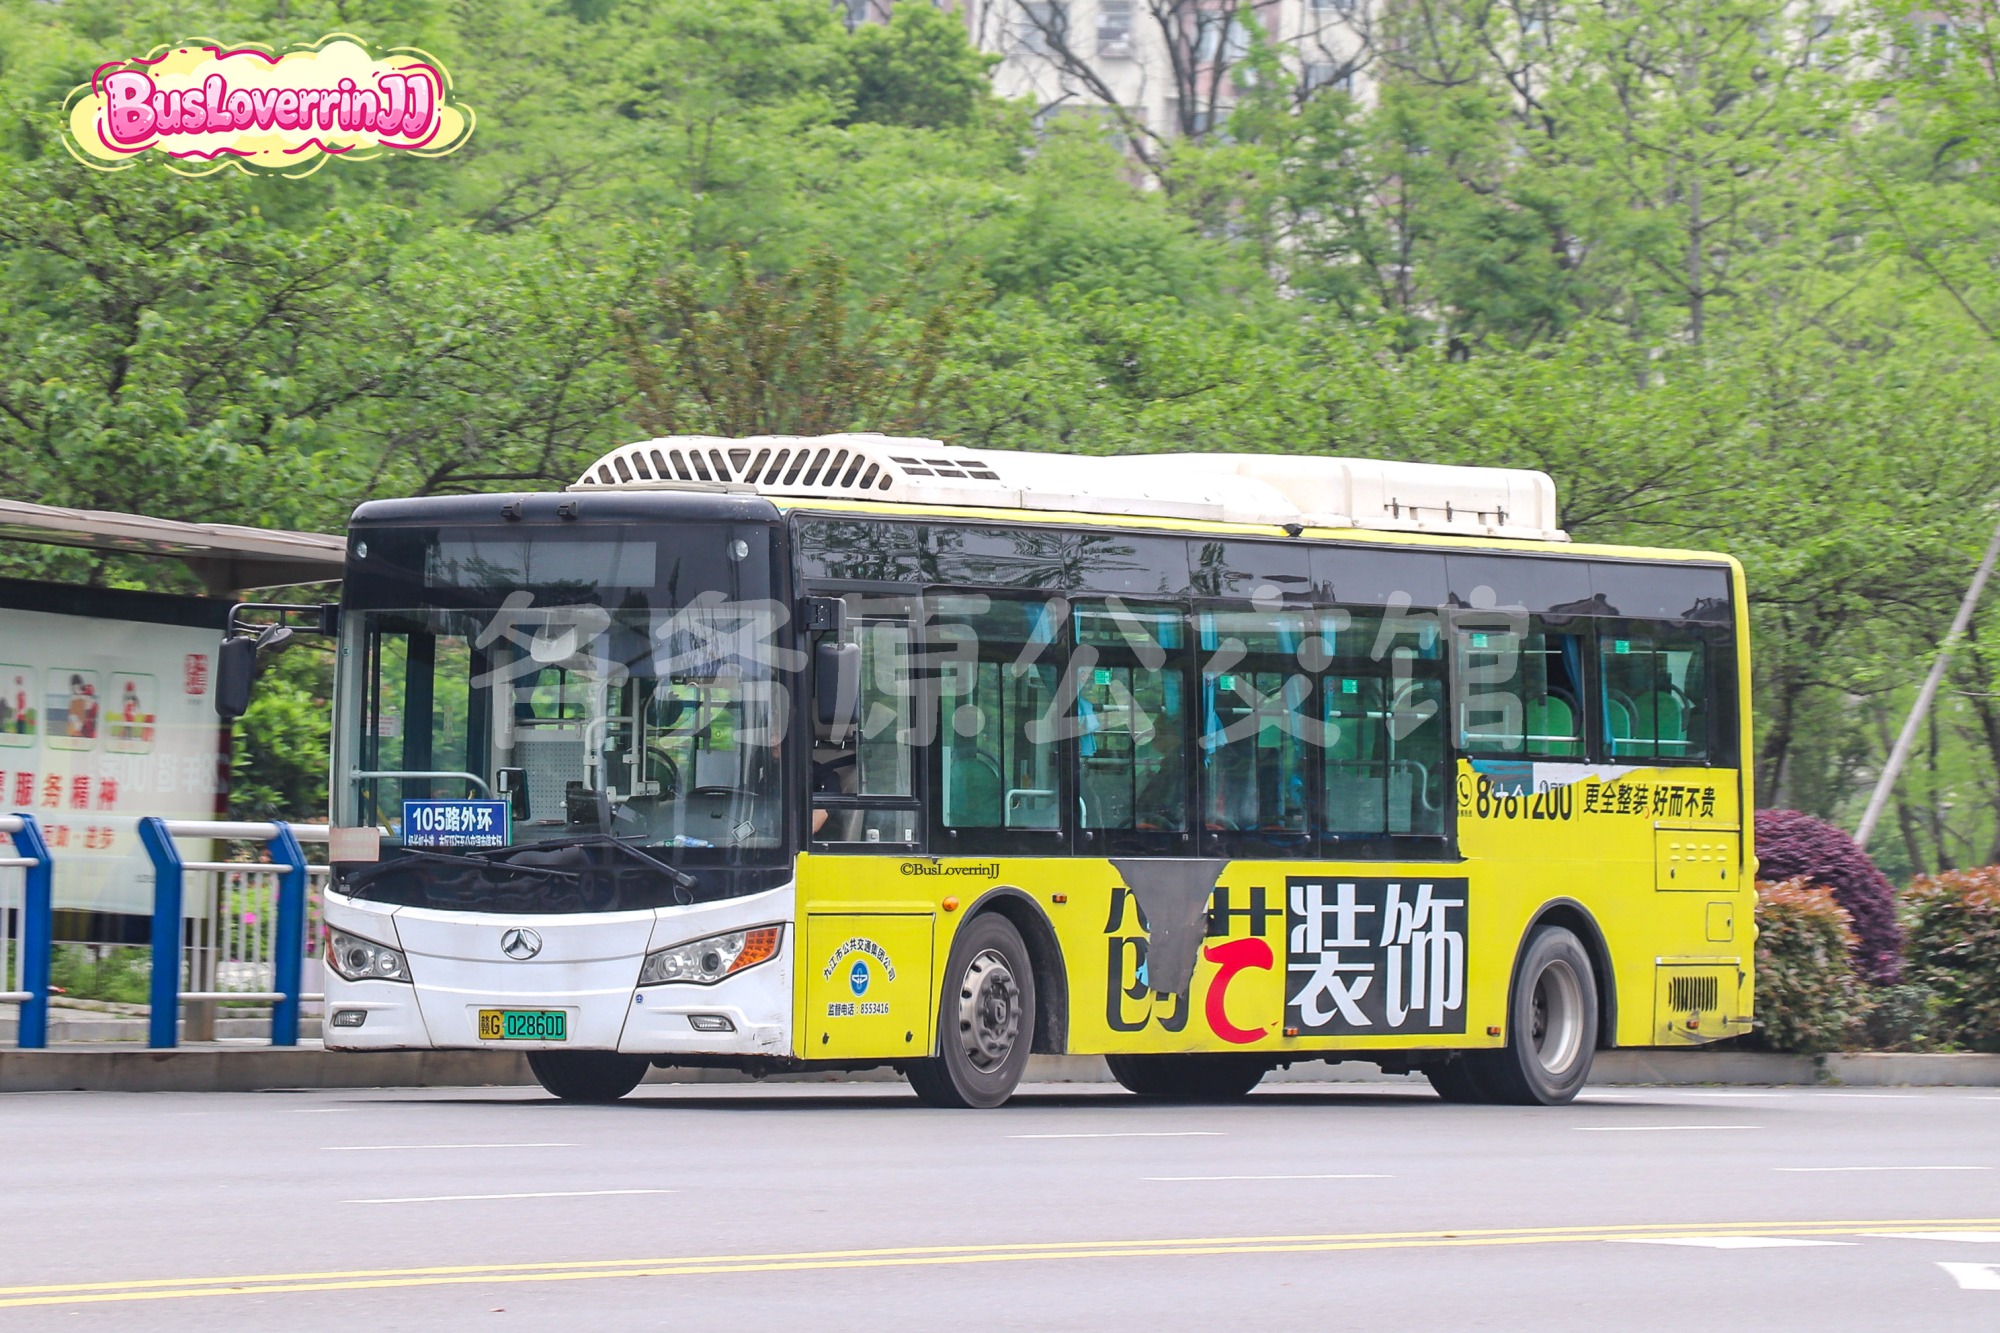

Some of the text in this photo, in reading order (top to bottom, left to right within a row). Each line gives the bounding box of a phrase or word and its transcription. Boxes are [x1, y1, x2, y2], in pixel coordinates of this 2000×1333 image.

[1583, 783, 1716, 818] 更全整装 好而不贵
[412, 806, 493, 832] 105路外环
